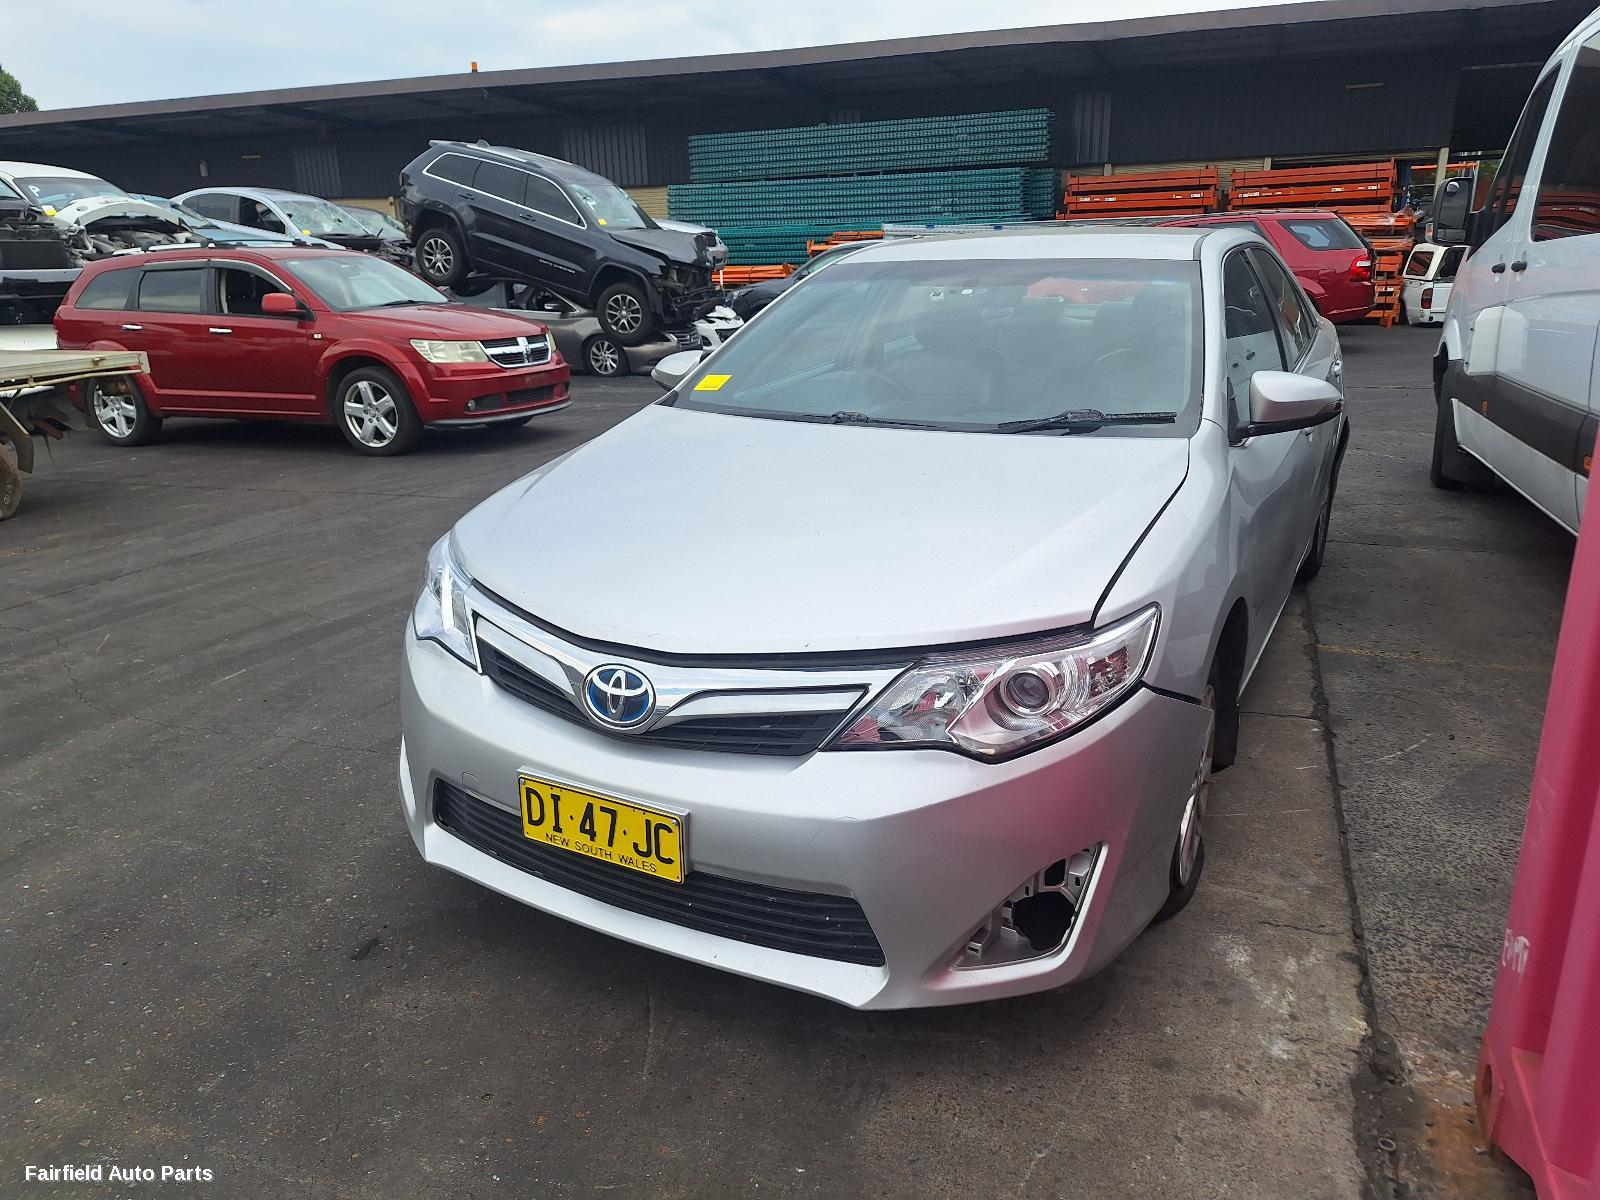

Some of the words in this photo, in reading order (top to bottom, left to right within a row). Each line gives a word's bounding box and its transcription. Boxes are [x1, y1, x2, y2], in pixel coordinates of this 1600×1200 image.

[545, 832, 571, 847] NEW
[575, 841, 612, 860] SOUTH
[618, 853, 657, 872] WALES
